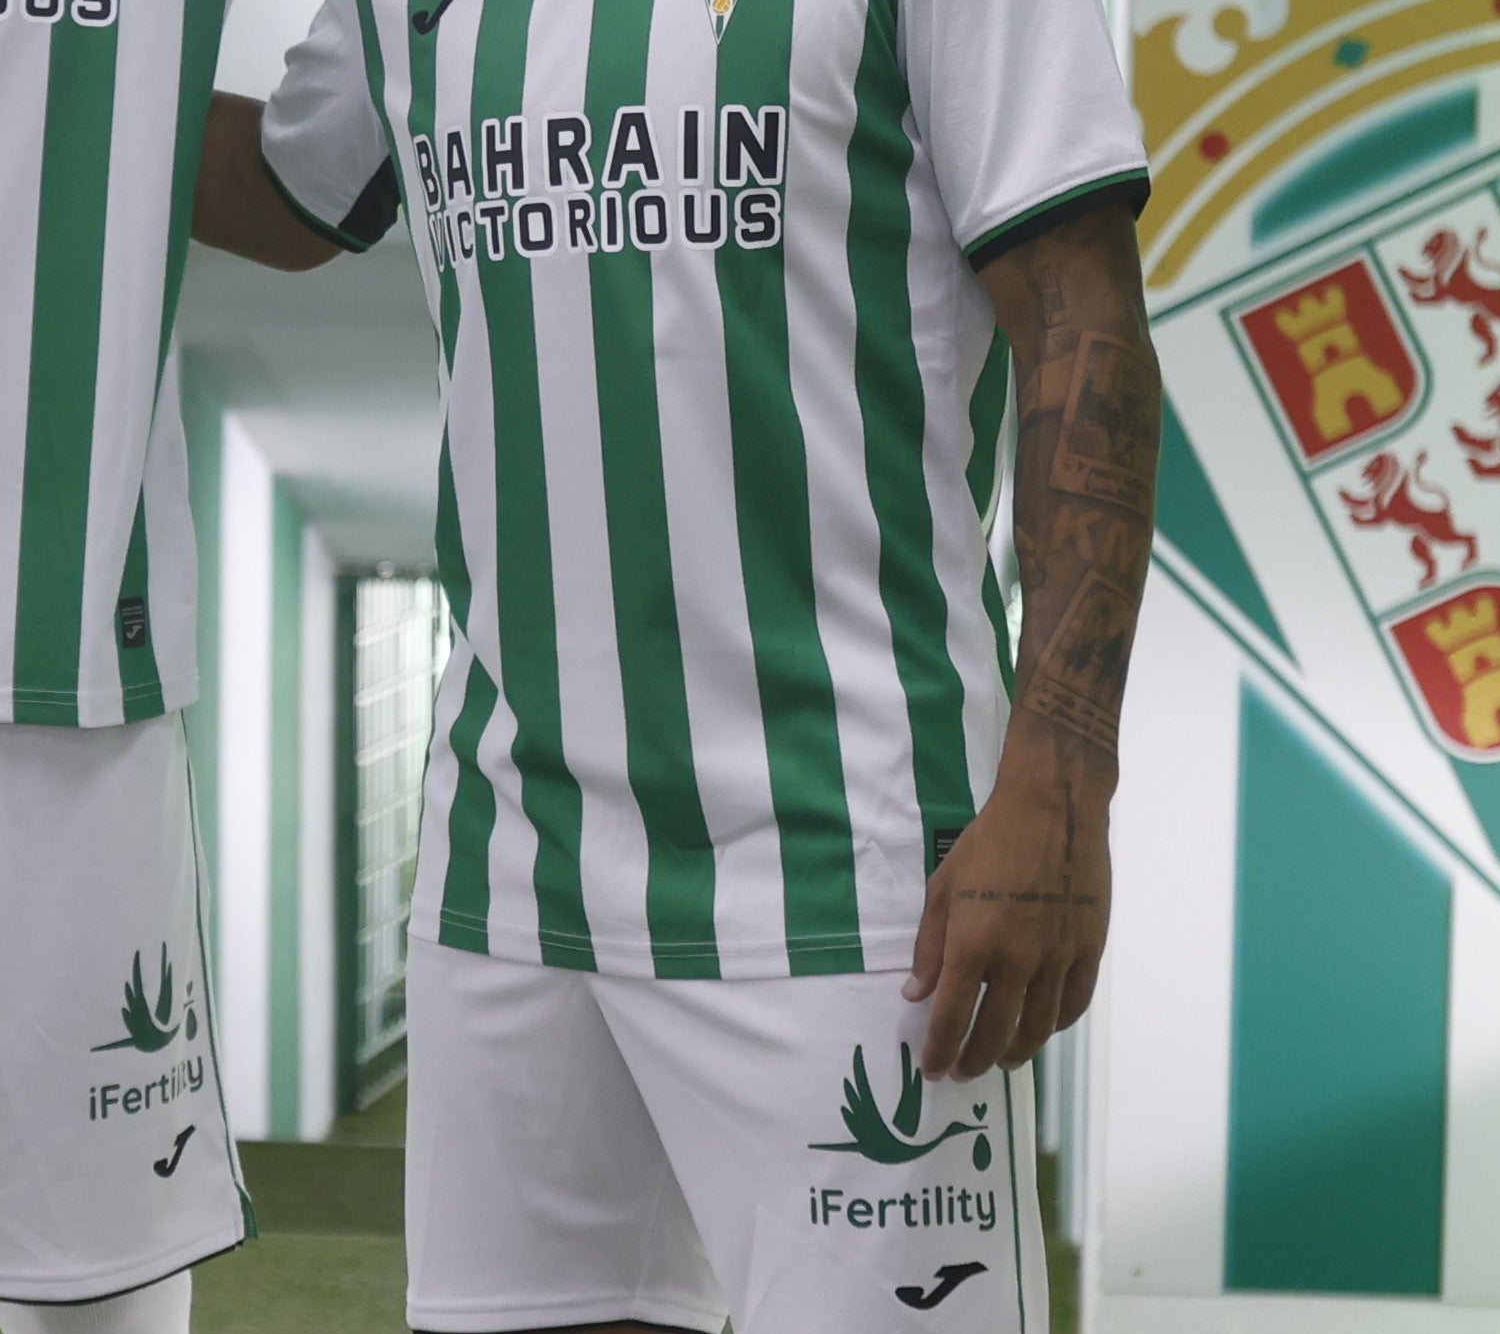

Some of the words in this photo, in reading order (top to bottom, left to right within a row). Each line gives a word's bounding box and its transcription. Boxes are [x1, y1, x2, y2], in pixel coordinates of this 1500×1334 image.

[414, 107, 785, 207] BAHRAIN
[427, 190, 782, 271] VICTORIOUS
[809, 1186, 997, 1231] iFertility
